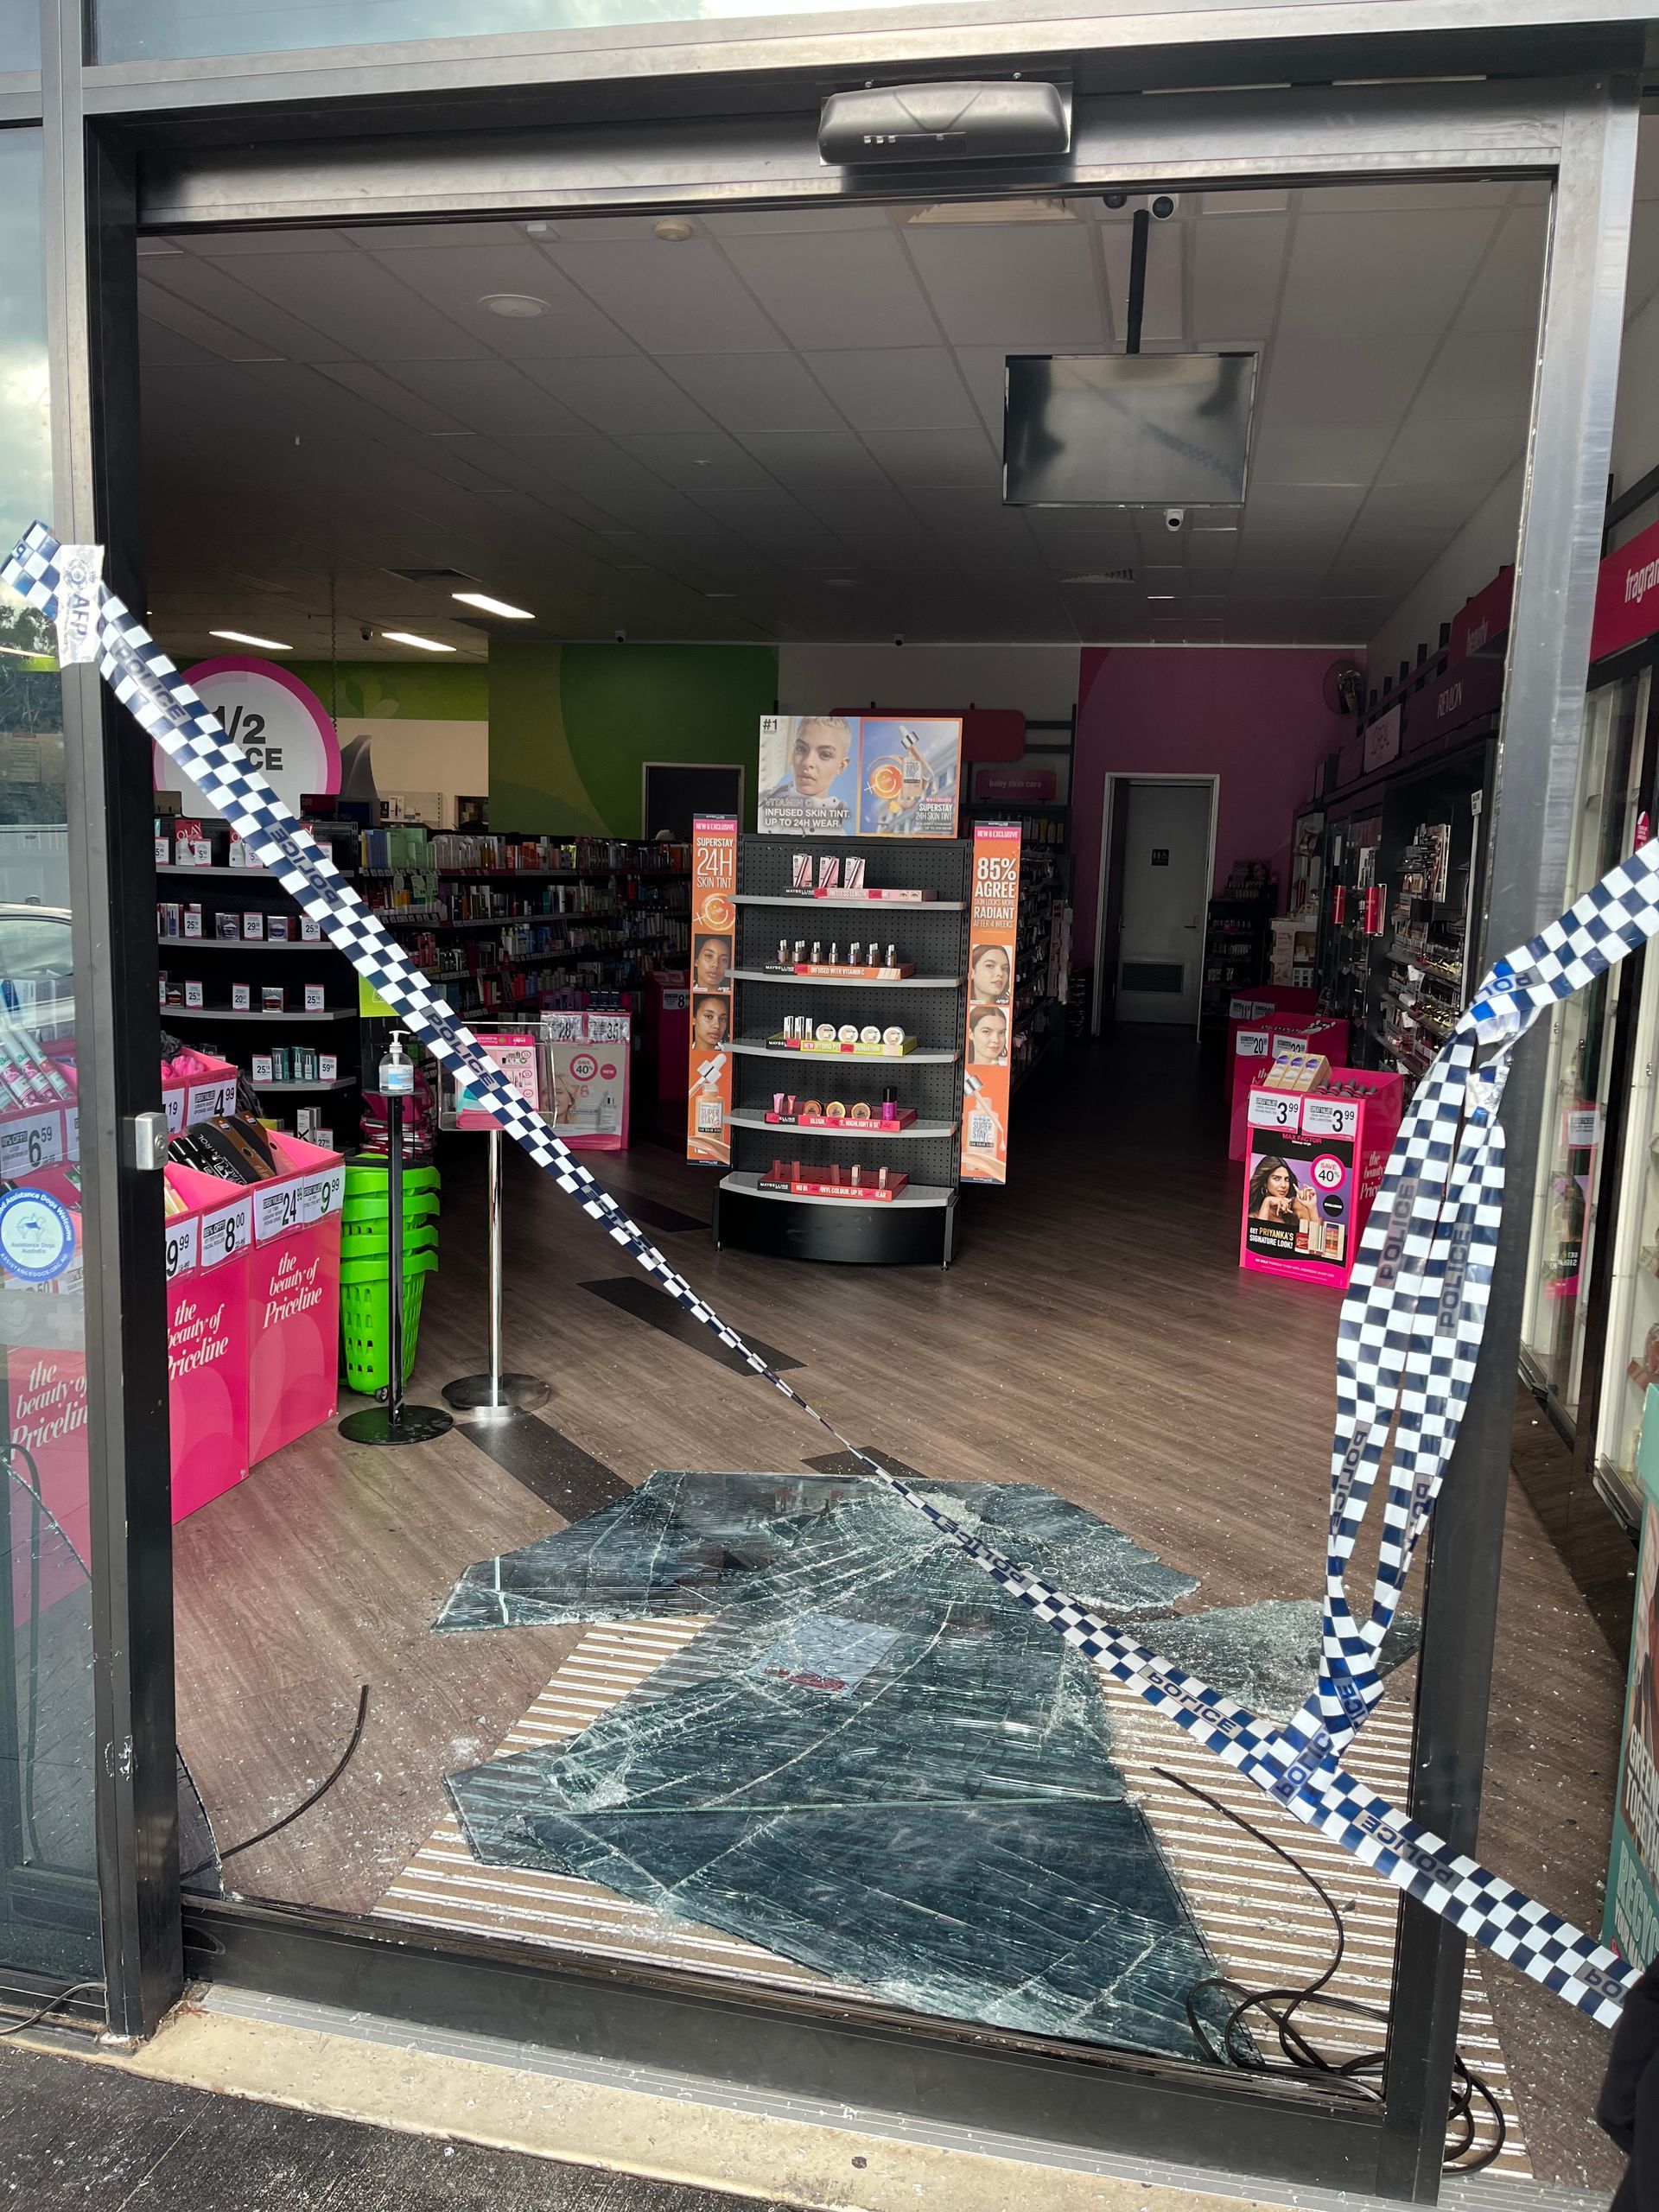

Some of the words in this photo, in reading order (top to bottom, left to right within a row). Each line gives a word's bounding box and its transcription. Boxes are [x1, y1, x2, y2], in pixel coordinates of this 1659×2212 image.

[1624, 558, 1659, 603] fragran
[114, 645, 187, 720] POLICE
[1437, 679, 1463, 719] REVLON
[763, 719, 778, 730] #1
[989, 779, 1007, 789] baby
[765, 809, 803, 817] INFUSED
[804, 809, 826, 817] SKIN
[829, 809, 850, 818] TINT.
[919, 803, 953, 812] SUPERSTAY
[793, 818, 811, 827] 24H
[176, 825, 202, 841] OLAY
[696, 837, 734, 848] SUPERSTAY
[269, 828, 340, 905] POLICE
[696, 847, 733, 877] 24H
[976, 857, 1017, 881] 85%
[696, 876, 715, 888] SKIN
[715, 877, 732, 888] TINT
[974, 880, 1016, 899] AGREE
[974, 906, 1015, 919] RADIANT
[187, 921, 195, 930] 25
[247, 922, 256, 931] 29
[995, 919, 1014, 928] WEEKS
[830, 967, 842, 976] WITH
[188, 992, 197, 1001] 25
[235, 995, 243, 1003] 20
[307, 995, 316, 1004] 25
[678, 995, 684, 1008] 8
[426, 1013, 495, 1087] POLICE
[1254, 1038, 1263, 1054] 20
[257, 1065, 266, 1074] 25
[322, 1064, 331, 1072] 59
[168, 1102, 178, 1116] 19
[214, 1089, 225, 1116] 4
[226, 1087, 235, 1101] 99
[1276, 1102, 1287, 1124] 3
[1288, 1103, 1299, 1113] 99
[1332, 1109, 1344, 1133] 3
[1344, 1110, 1355, 1121] 99
[28, 1130, 41, 1167] 6
[41, 1126, 52, 1142] 59
[1297, 1135, 1322, 1144] FACTOR
[1320, 1162, 1337, 1171] SAVE
[1369, 1150, 1381, 1167] the
[1318, 1169, 1340, 1182] 40%
[321, 1181, 331, 1214] 9
[331, 1178, 340, 1192] 99
[5, 1192, 41, 1206] Assistance
[40, 1193, 58, 1210] Dogs
[56, 1206, 73, 1242] Welcome
[282, 1189, 296, 1227] 24
[226, 1217, 235, 1253] 8
[236, 1211, 245, 1229] 00
[1259, 1227, 1294, 1242] PRIYANKA'S
[1379, 1184, 1416, 1279] POLICE
[179, 1234, 189, 1251] 99
[1249, 1234, 1277, 1247] SIGNATURE
[1277, 1240, 1294, 1249] LOOK!
[277, 1251, 297, 1276] the
[269, 1268, 303, 1297] beauty
[306, 1257, 320, 1286] of
[1440, 1229, 1471, 1329] POLICE
[174, 1299, 197, 1327] the
[262, 1287, 322, 1330] Priceline
[208, 1303, 226, 1335] of
[29, 1359, 57, 1392] the
[16, 1380, 73, 1420] beauty
[11, 1400, 88, 1461] Pricelin
[943, 1516, 1029, 1583] POLICE
[1361, 1814, 1456, 1885] POLICE
